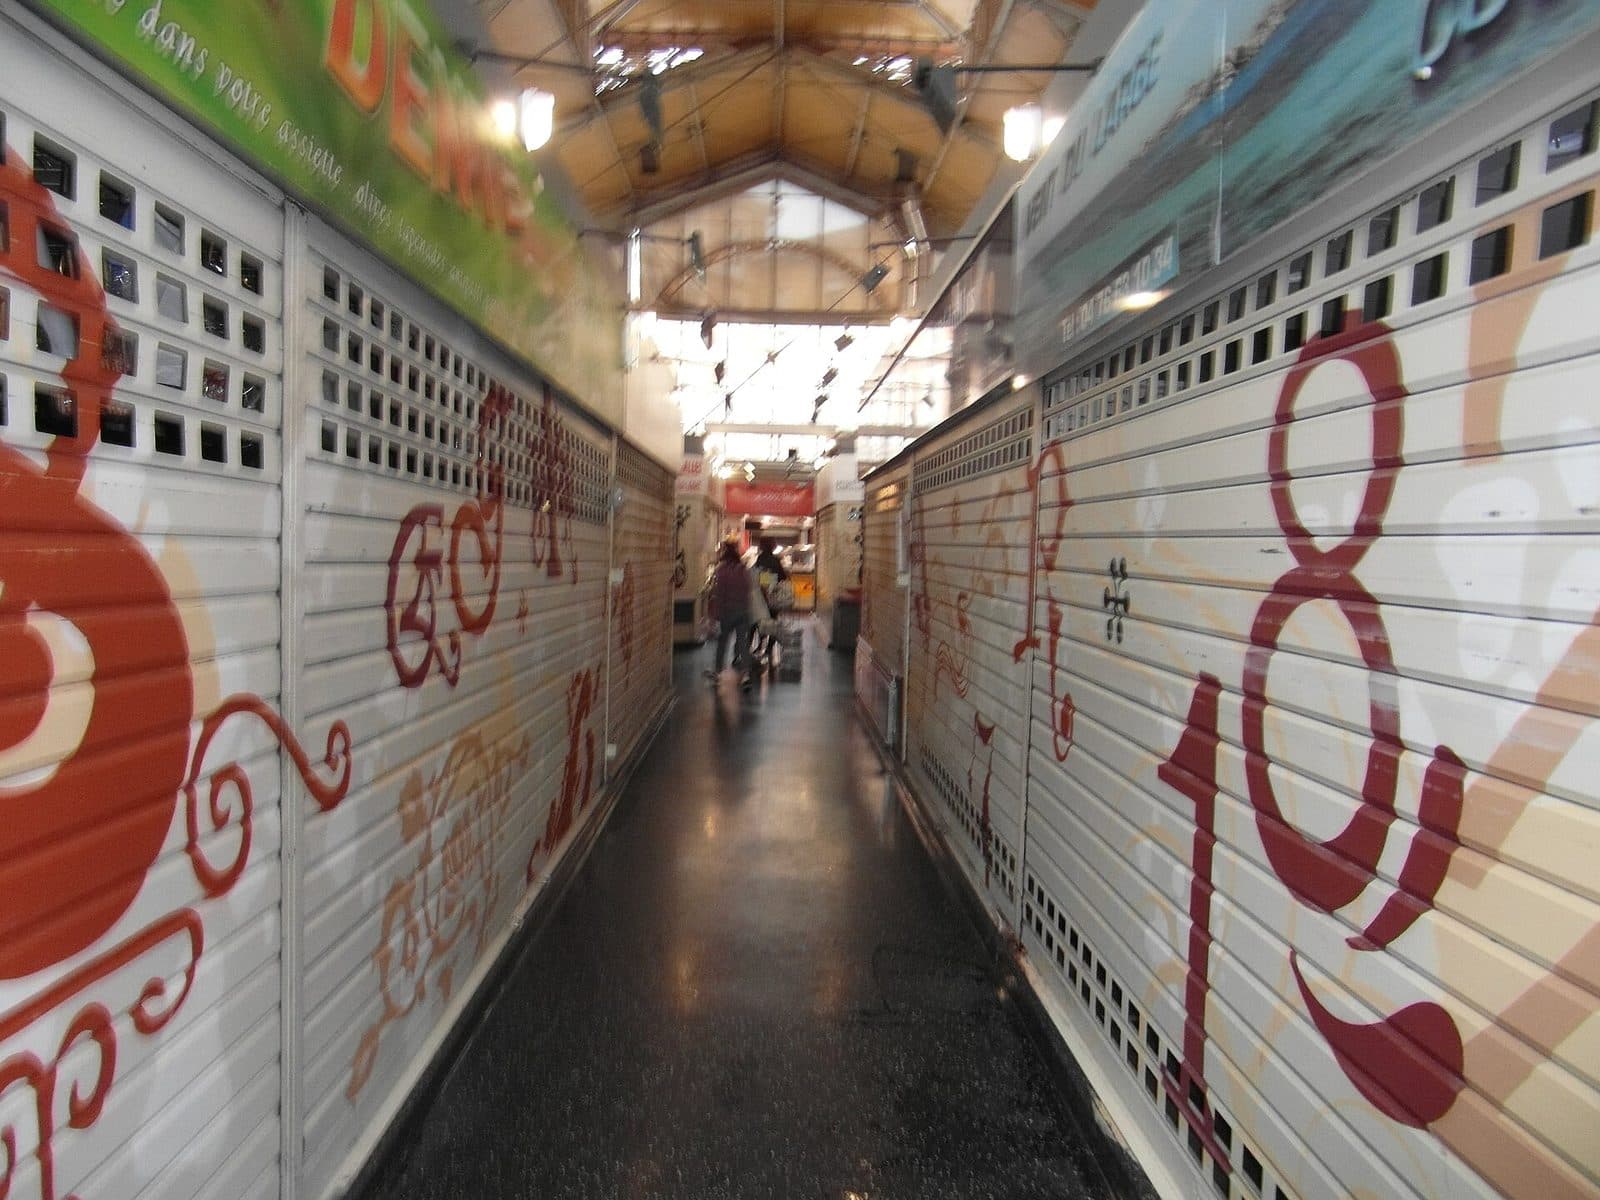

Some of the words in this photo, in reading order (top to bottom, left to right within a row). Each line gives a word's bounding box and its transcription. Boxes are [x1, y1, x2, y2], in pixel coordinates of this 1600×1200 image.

[140, 0, 209, 74] dans
[216, 61, 272, 126] votre
[279, 119, 343, 184] assiette
